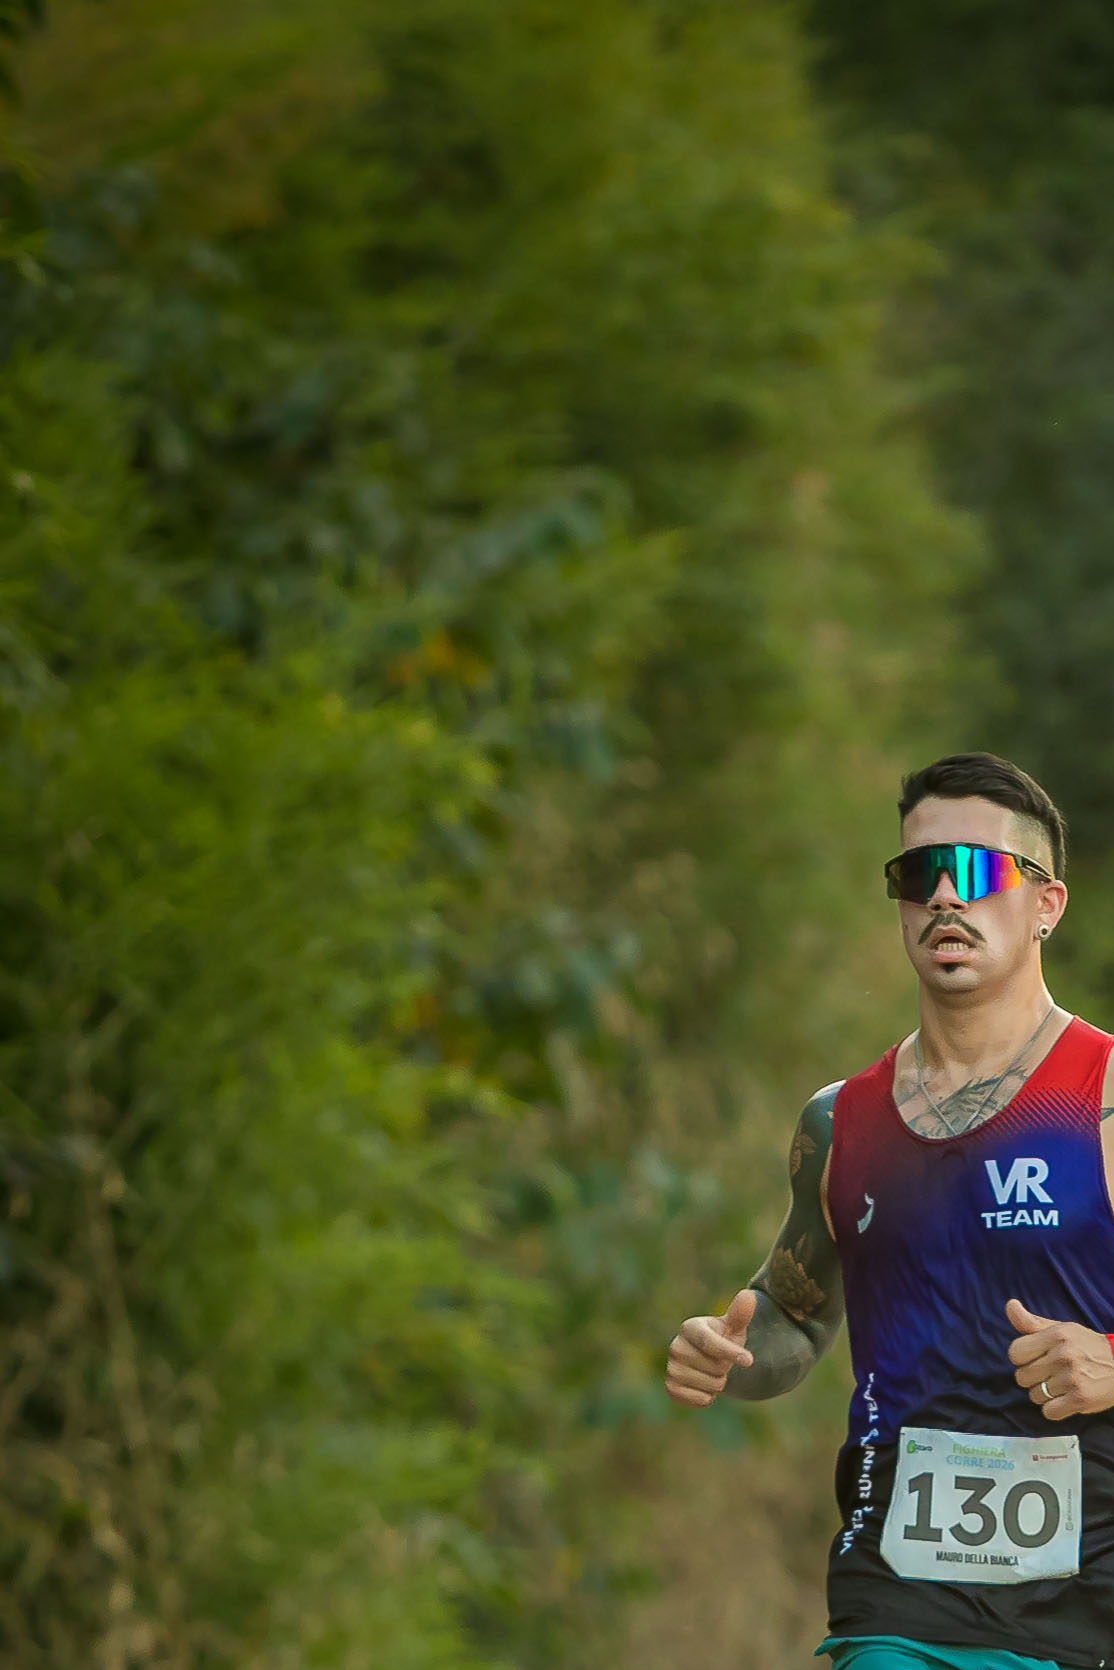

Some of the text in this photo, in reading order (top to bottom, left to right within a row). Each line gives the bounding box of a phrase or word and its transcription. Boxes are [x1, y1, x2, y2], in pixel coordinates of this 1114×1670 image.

[984, 1157, 1054, 1205] VR
[980, 1209, 1059, 1229] TEAM
[945, 1454, 1015, 1471] CORRE 2026
[903, 1471, 1060, 1548] 130
[936, 1551, 1019, 1566] MAURO DELLA BIANCA
